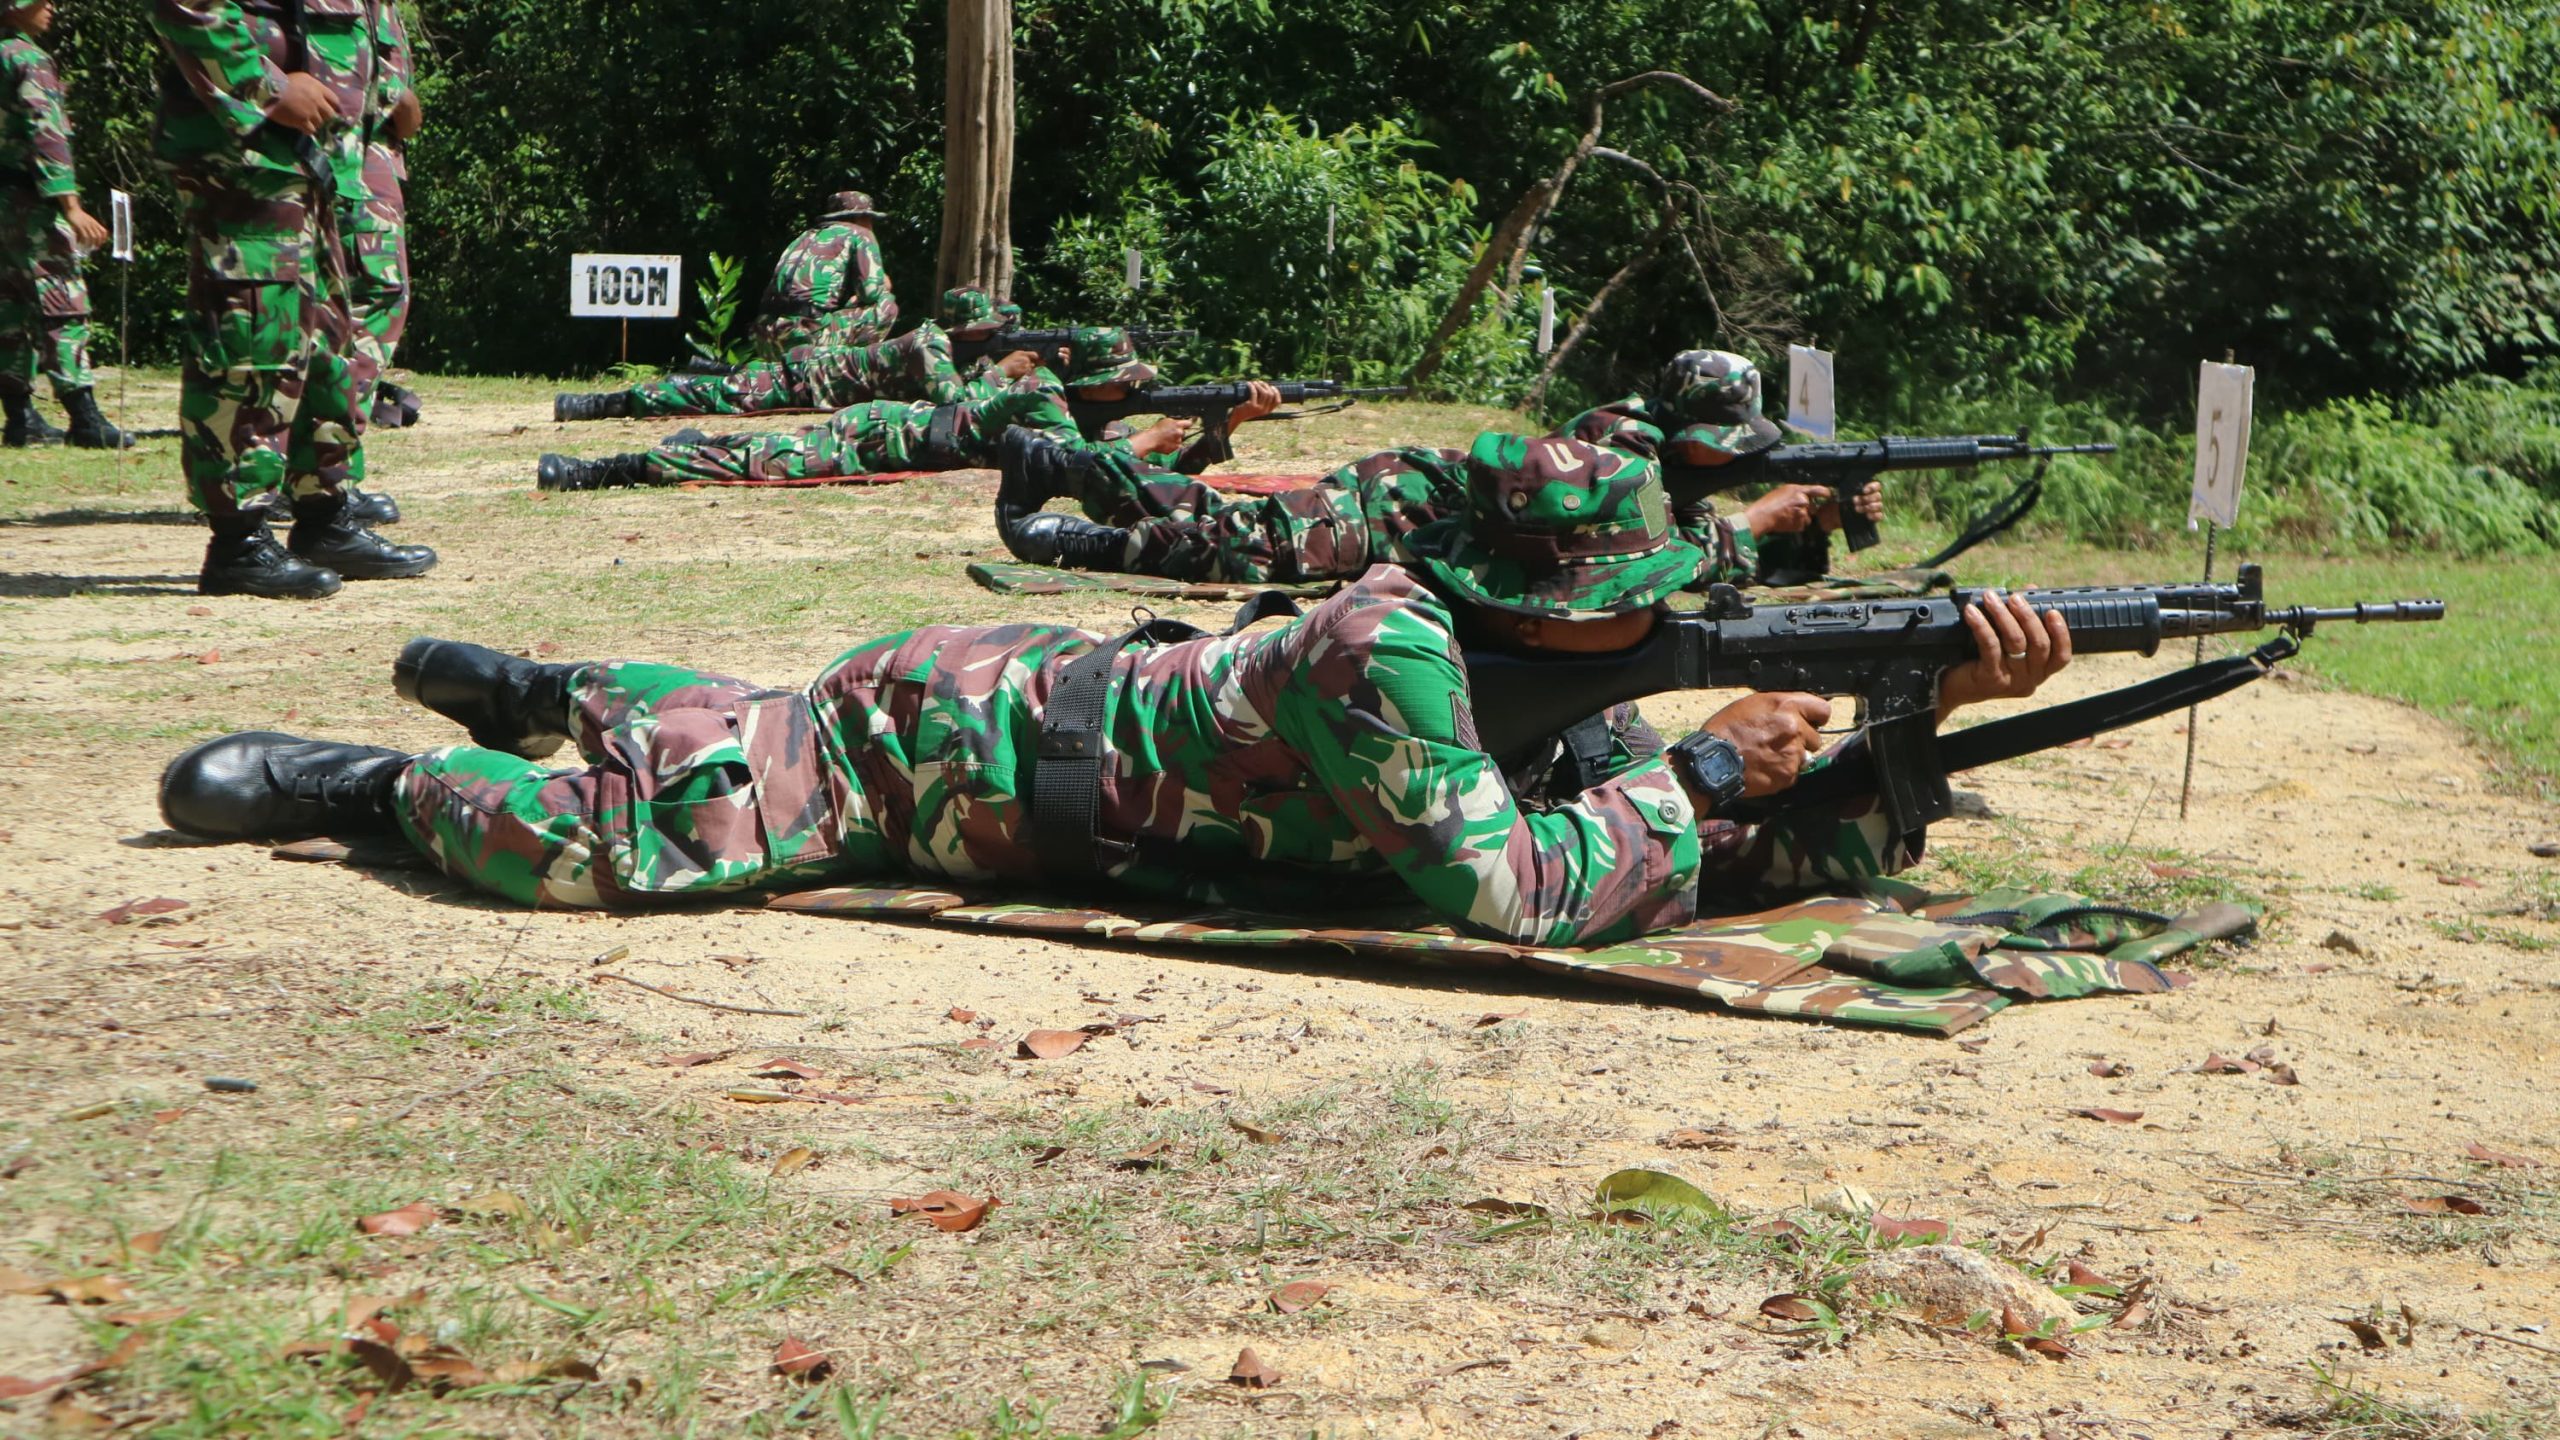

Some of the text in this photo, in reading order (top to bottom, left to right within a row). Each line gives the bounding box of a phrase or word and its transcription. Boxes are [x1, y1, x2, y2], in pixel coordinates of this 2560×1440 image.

[586, 265, 669, 306] 100M
[1799, 371, 1809, 416] 4
[2207, 409, 2222, 488] 5
